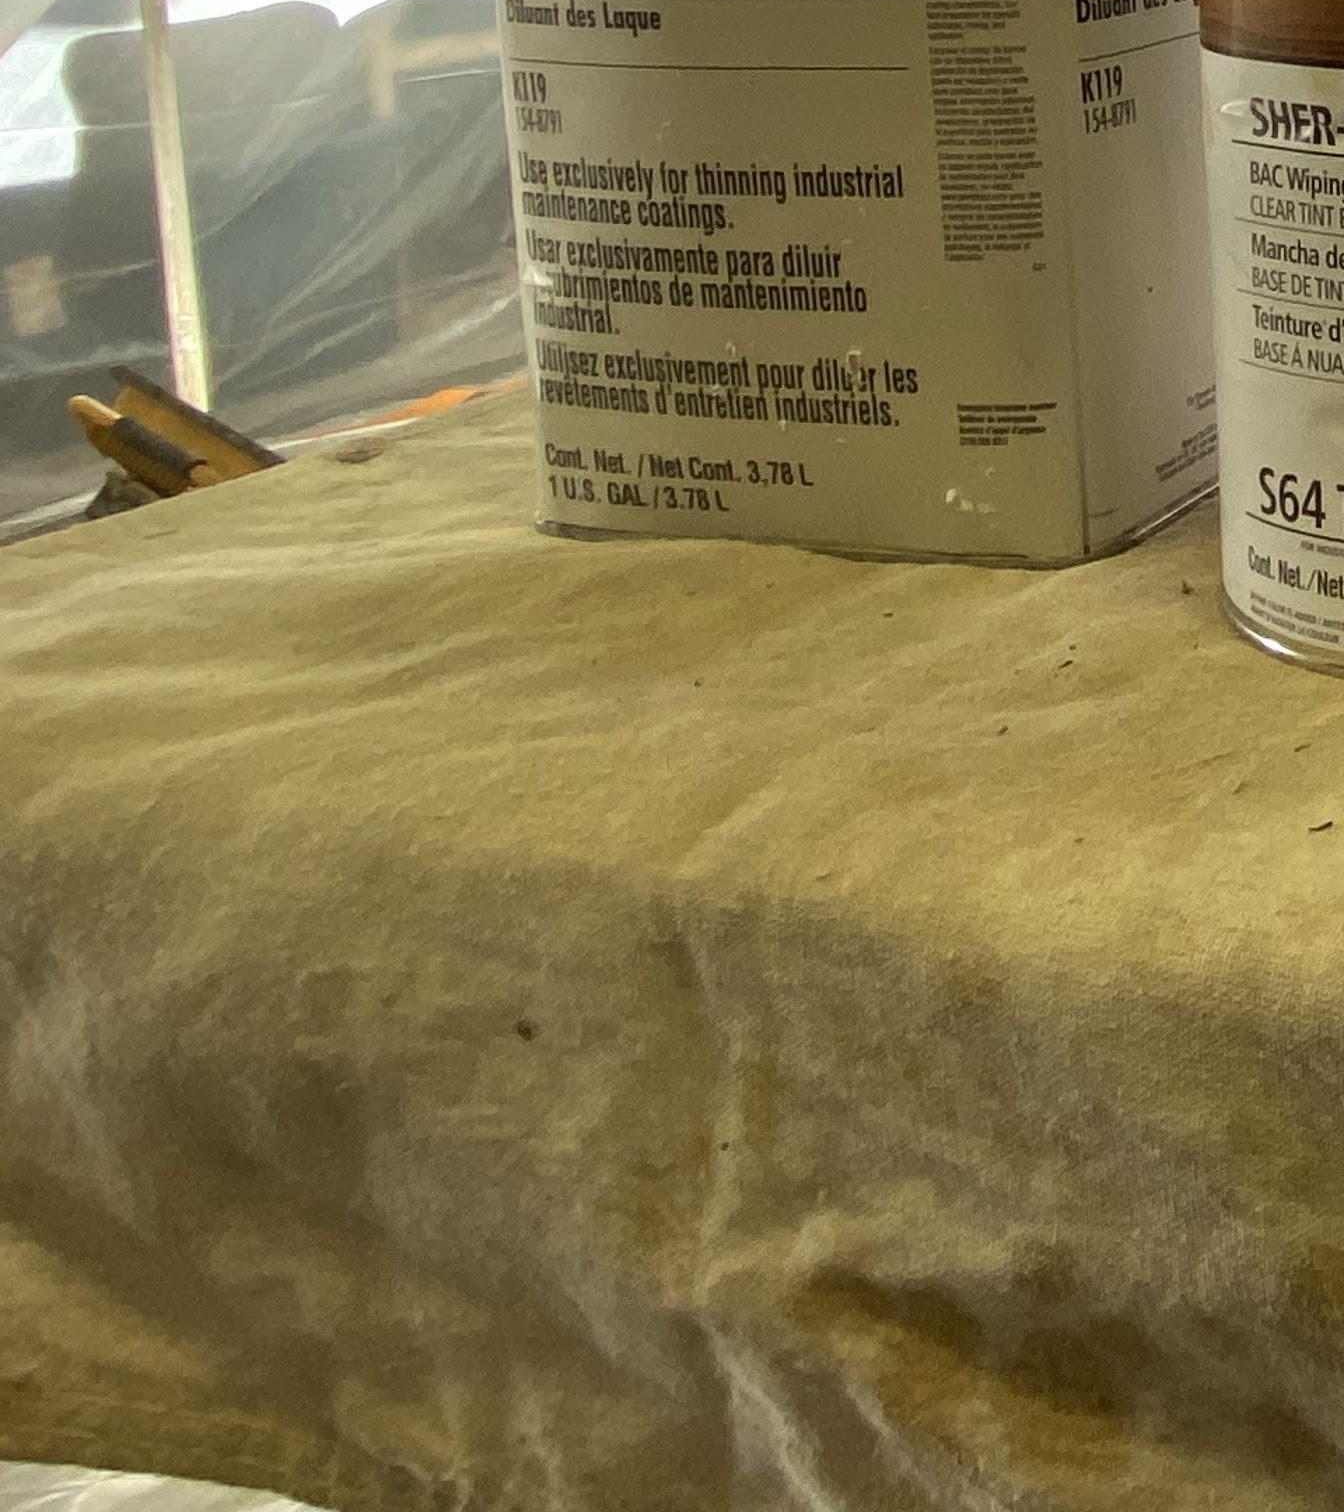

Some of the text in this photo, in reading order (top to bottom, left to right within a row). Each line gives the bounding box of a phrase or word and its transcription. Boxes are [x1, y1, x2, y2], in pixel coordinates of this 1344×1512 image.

[603, 1, 661, 38] Laque
[512, 71, 547, 104] K119
[1081, 65, 1123, 104] K119
[518, 150, 904, 204] Use exclusively for thinning industrial
[1250, 160, 1283, 188] BAC
[523, 187, 735, 236] maintenance coatings.
[1250, 194, 1296, 223] CLEAR
[1298, 202, 1335, 230] TINT
[526, 227, 841, 283] Usar exclusivamente para diluir
[1251, 233, 1319, 267] Mancha
[668, 274, 867, 313] de mantenimiento
[1252, 266, 1287, 294] BASE
[1291, 273, 1312, 298] DE
[1252, 304, 1323, 339] Teinture
[1254, 338, 1288, 366] BASE
[604, 349, 919, 395] exclusivement pour les
[776, 388, 900, 426] industriels.
[649, 454, 742, 483] Net Cont.
[563, 477, 648, 507] U.S. GAL
[1259, 467, 1326, 529] S64
[1248, 545, 1275, 580] Cont.
